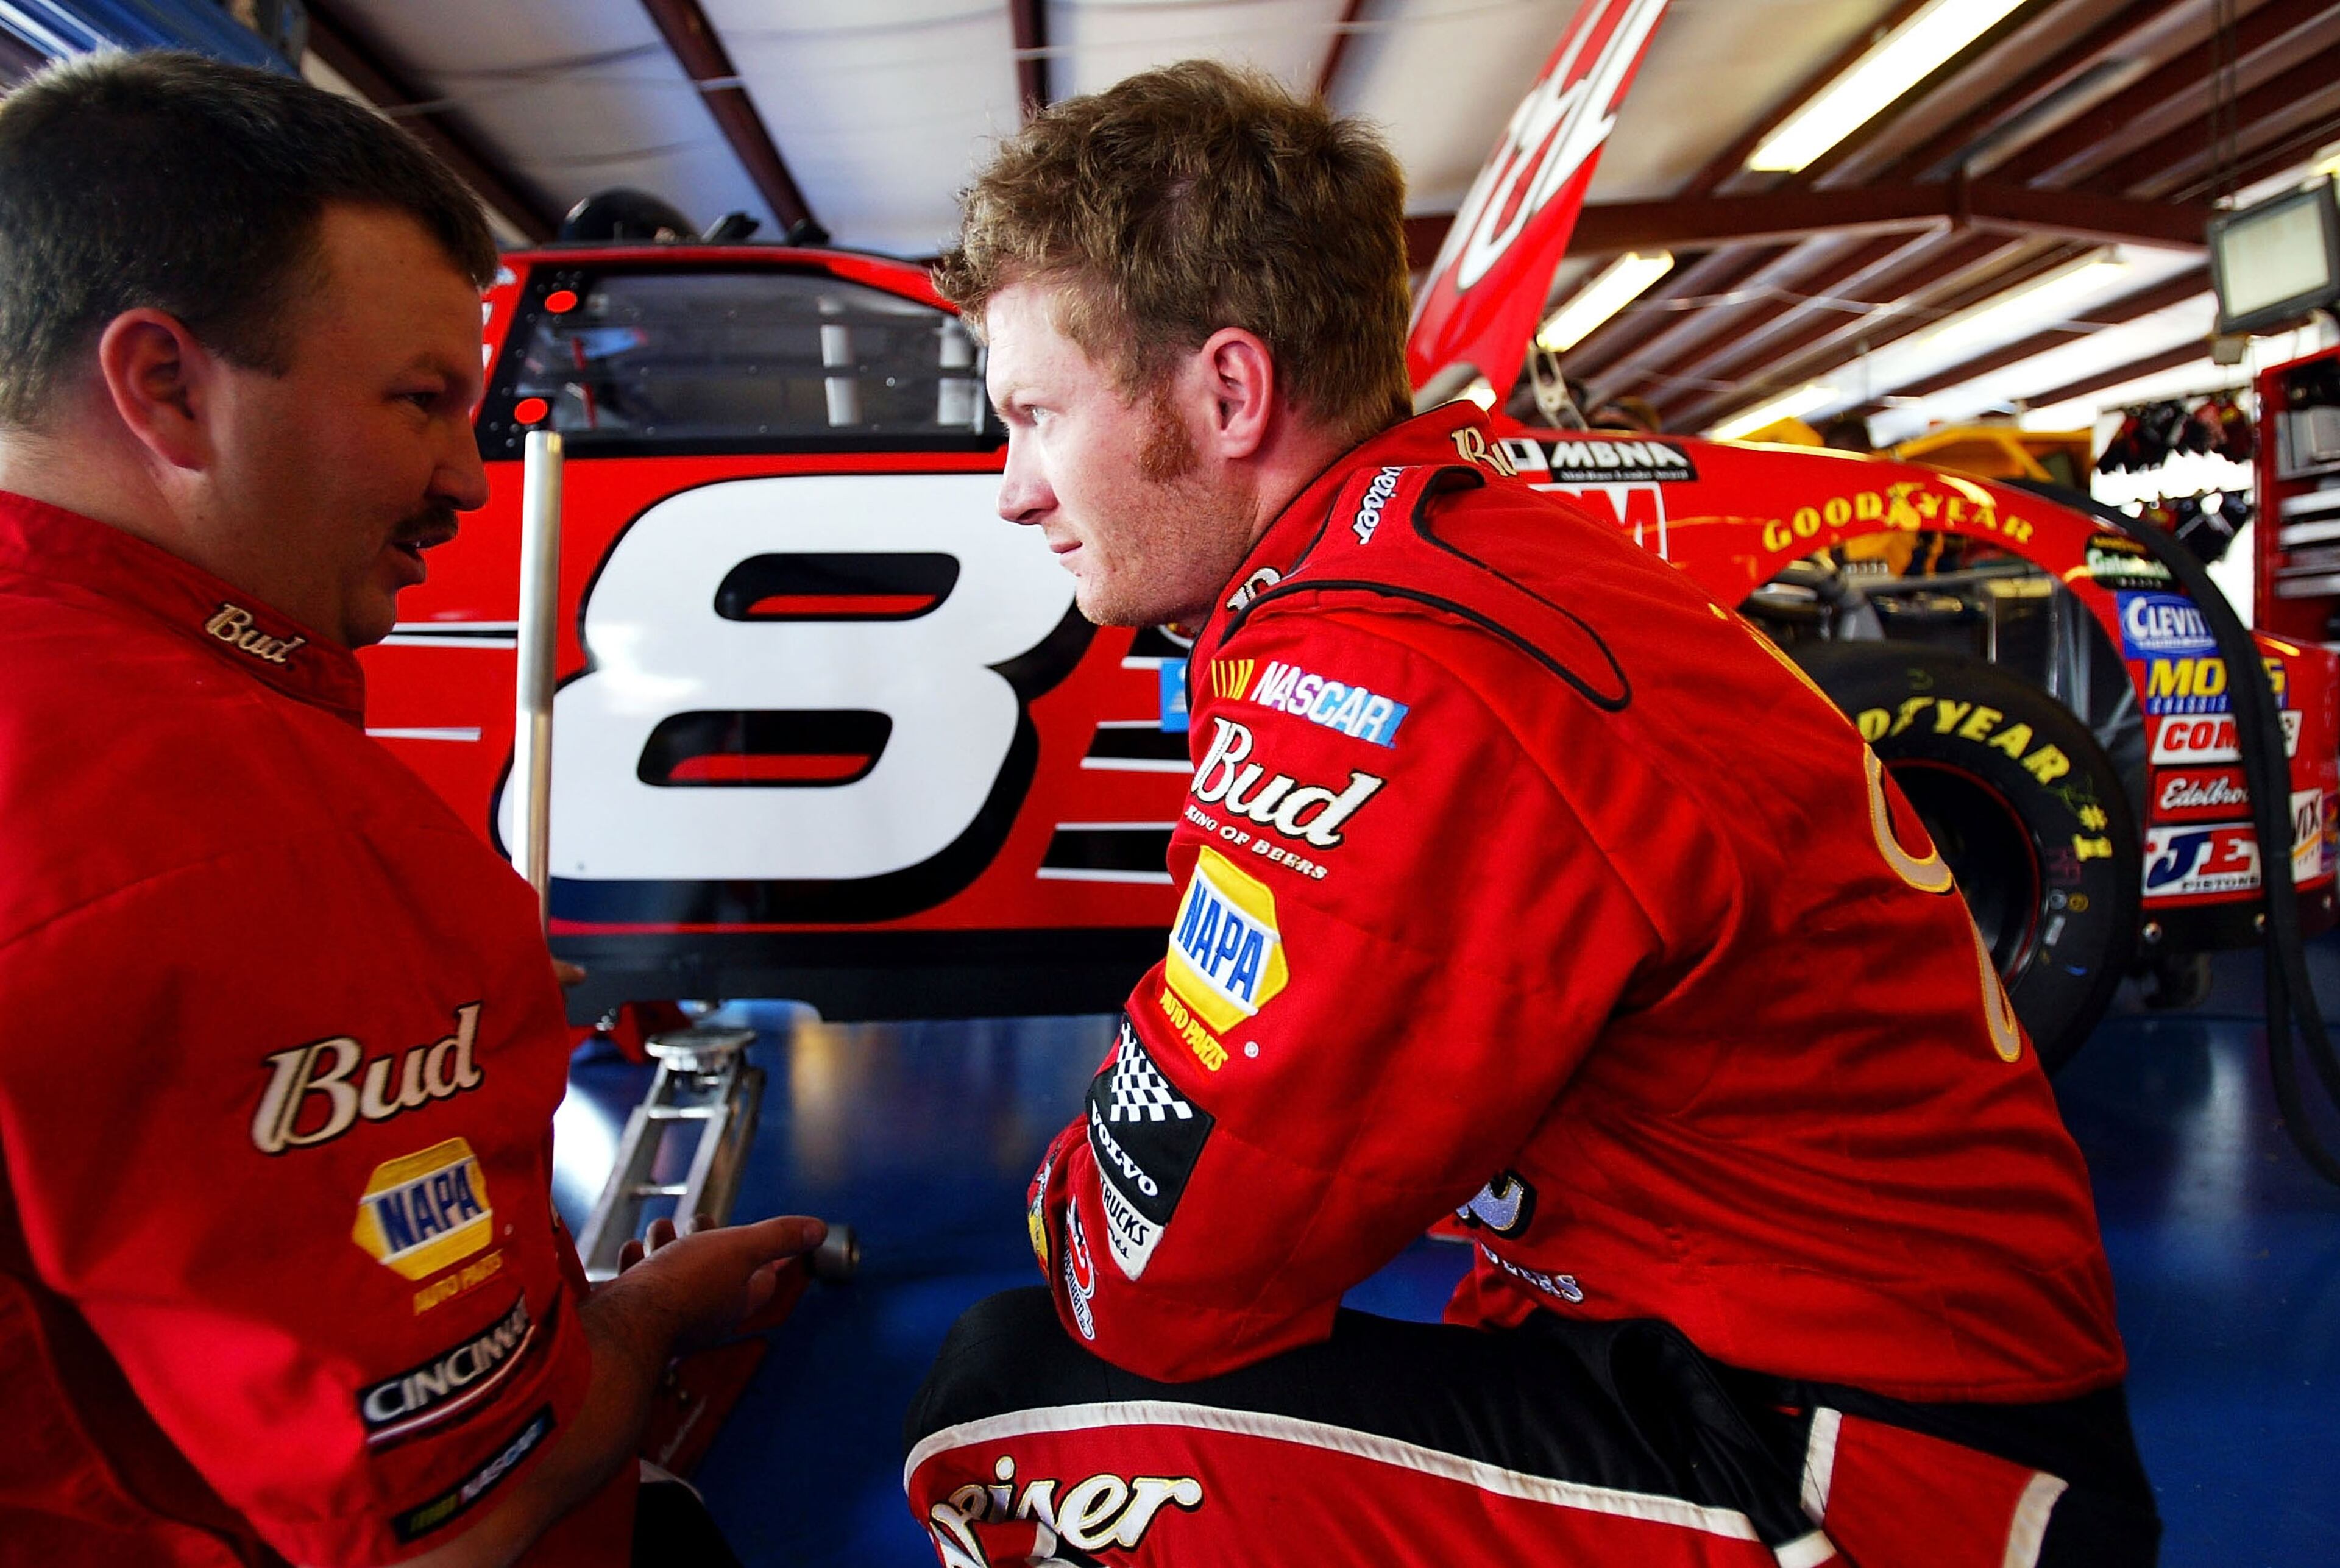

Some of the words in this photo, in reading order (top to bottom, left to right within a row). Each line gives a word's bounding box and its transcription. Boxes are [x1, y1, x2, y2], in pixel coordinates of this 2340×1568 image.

[1550, 441, 1689, 468] MBNA
[1763, 482, 2034, 552] GOODYEAR
[205, 603, 306, 663] Bud
[2127, 596, 2206, 639] CLEVIT
[495, 473, 1079, 881] 8
[1250, 661, 1394, 744] NASCAR
[1857, 697, 2071, 786] DYEAR
[2163, 720, 2241, 751] COM
[1190, 716, 1383, 846] Bud
[2161, 775, 2249, 811] Edelbro
[1184, 804, 1218, 832] KING
[1220, 825, 1250, 846] OF
[1252, 838, 1329, 881] BEERS
[2147, 829, 2257, 889] JE
[1177, 878, 1266, 1004] NAPA
[1159, 986, 1185, 1030] AUTO
[1182, 1013, 1228, 1072] PARTS
[252, 1003, 483, 1152] Bud
[1093, 1099, 1158, 1197] VOLVO
[375, 1162, 483, 1254] NAPA
